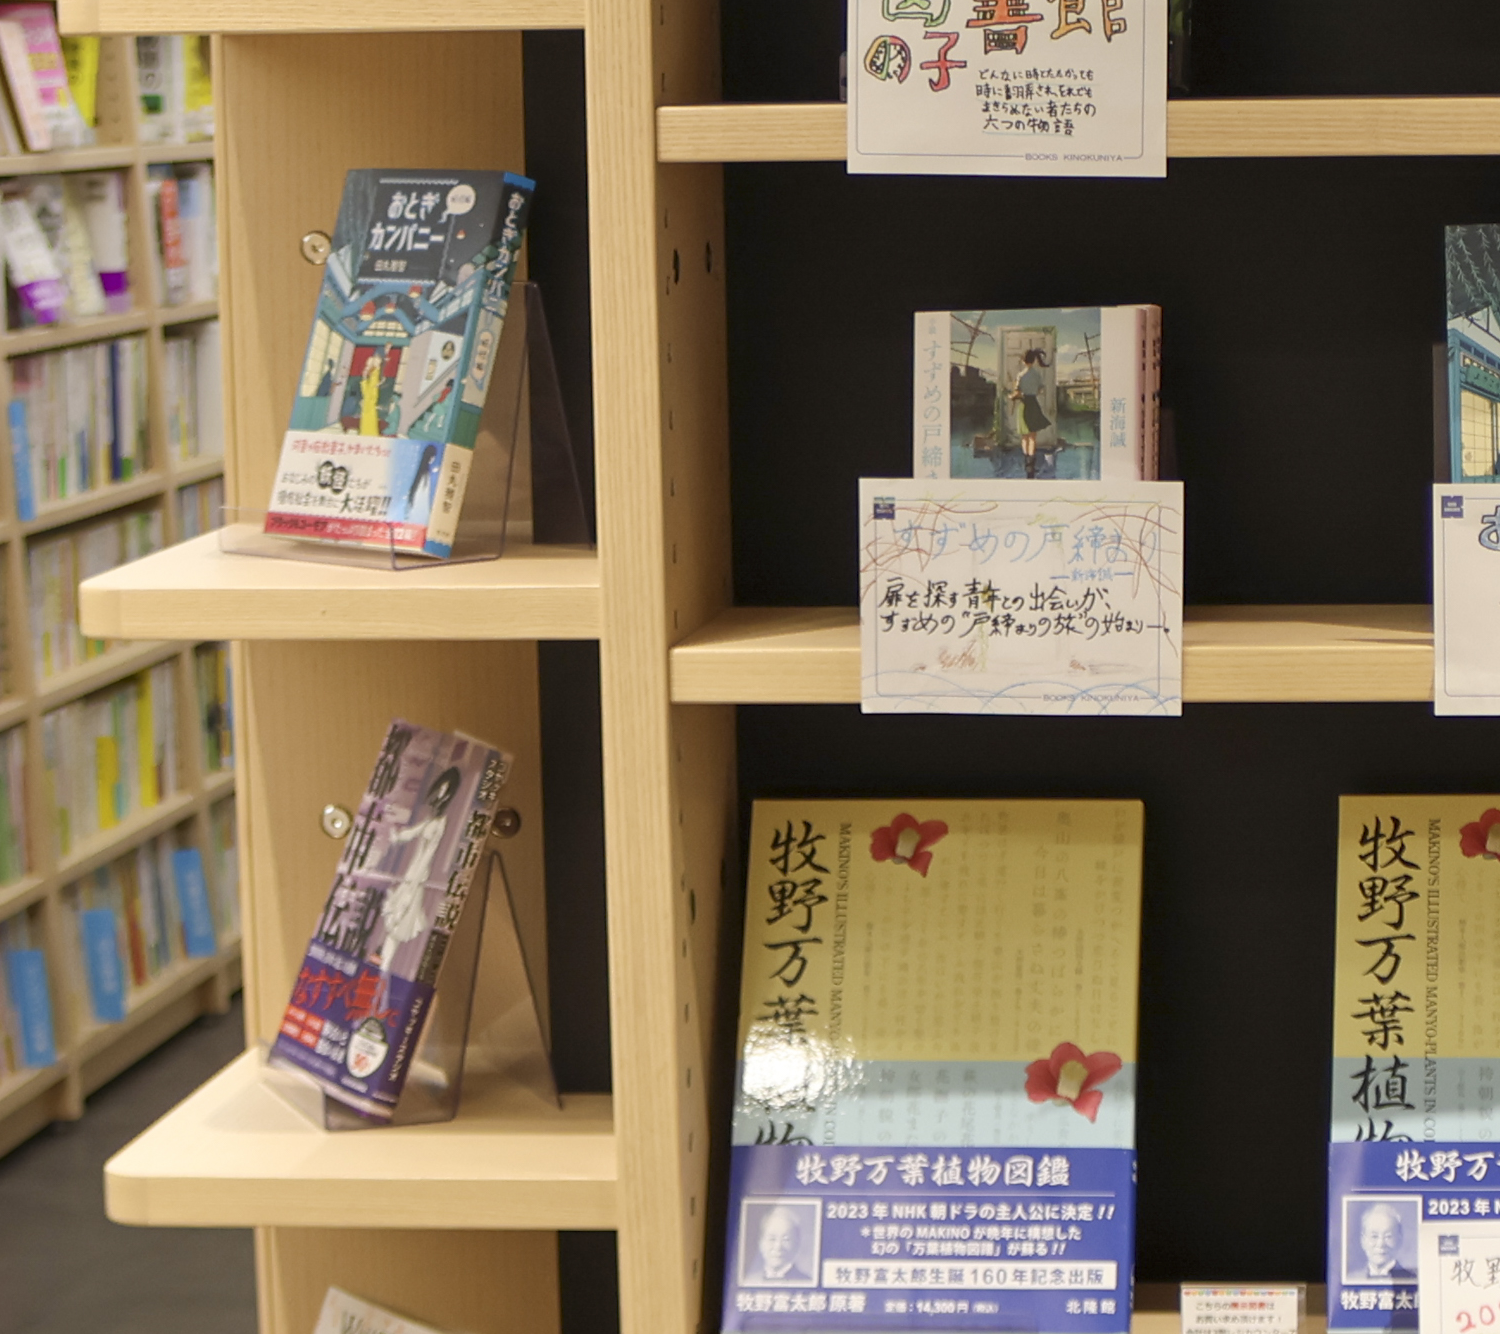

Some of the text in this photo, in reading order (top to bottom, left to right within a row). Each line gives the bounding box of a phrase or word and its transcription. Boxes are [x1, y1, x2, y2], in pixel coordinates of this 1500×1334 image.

[983, 113, 1076, 136] 六つの物語
[1025, 152, 1124, 163] BOOKS KINOKUNIYA
[387, 191, 440, 220] おとぎ
[368, 224, 447, 252] カンパニー
[894, 520, 1159, 565] すずめの戸締まり
[1043, 694, 1075, 704] BOOKS
[833, 888, 850, 987] ILLUSTRATED
[1425, 886, 1441, 983] ILLUSTRATED
[796, 1153, 1071, 1187] 牧野万葉植物図鑑
[835, 1267, 1105, 1286] 牧野富太郎生誕160年記念出版
[736, 1293, 866, 1313] 牧野富太郎 原著
[1065, 1298, 1116, 1315] 北隆館
